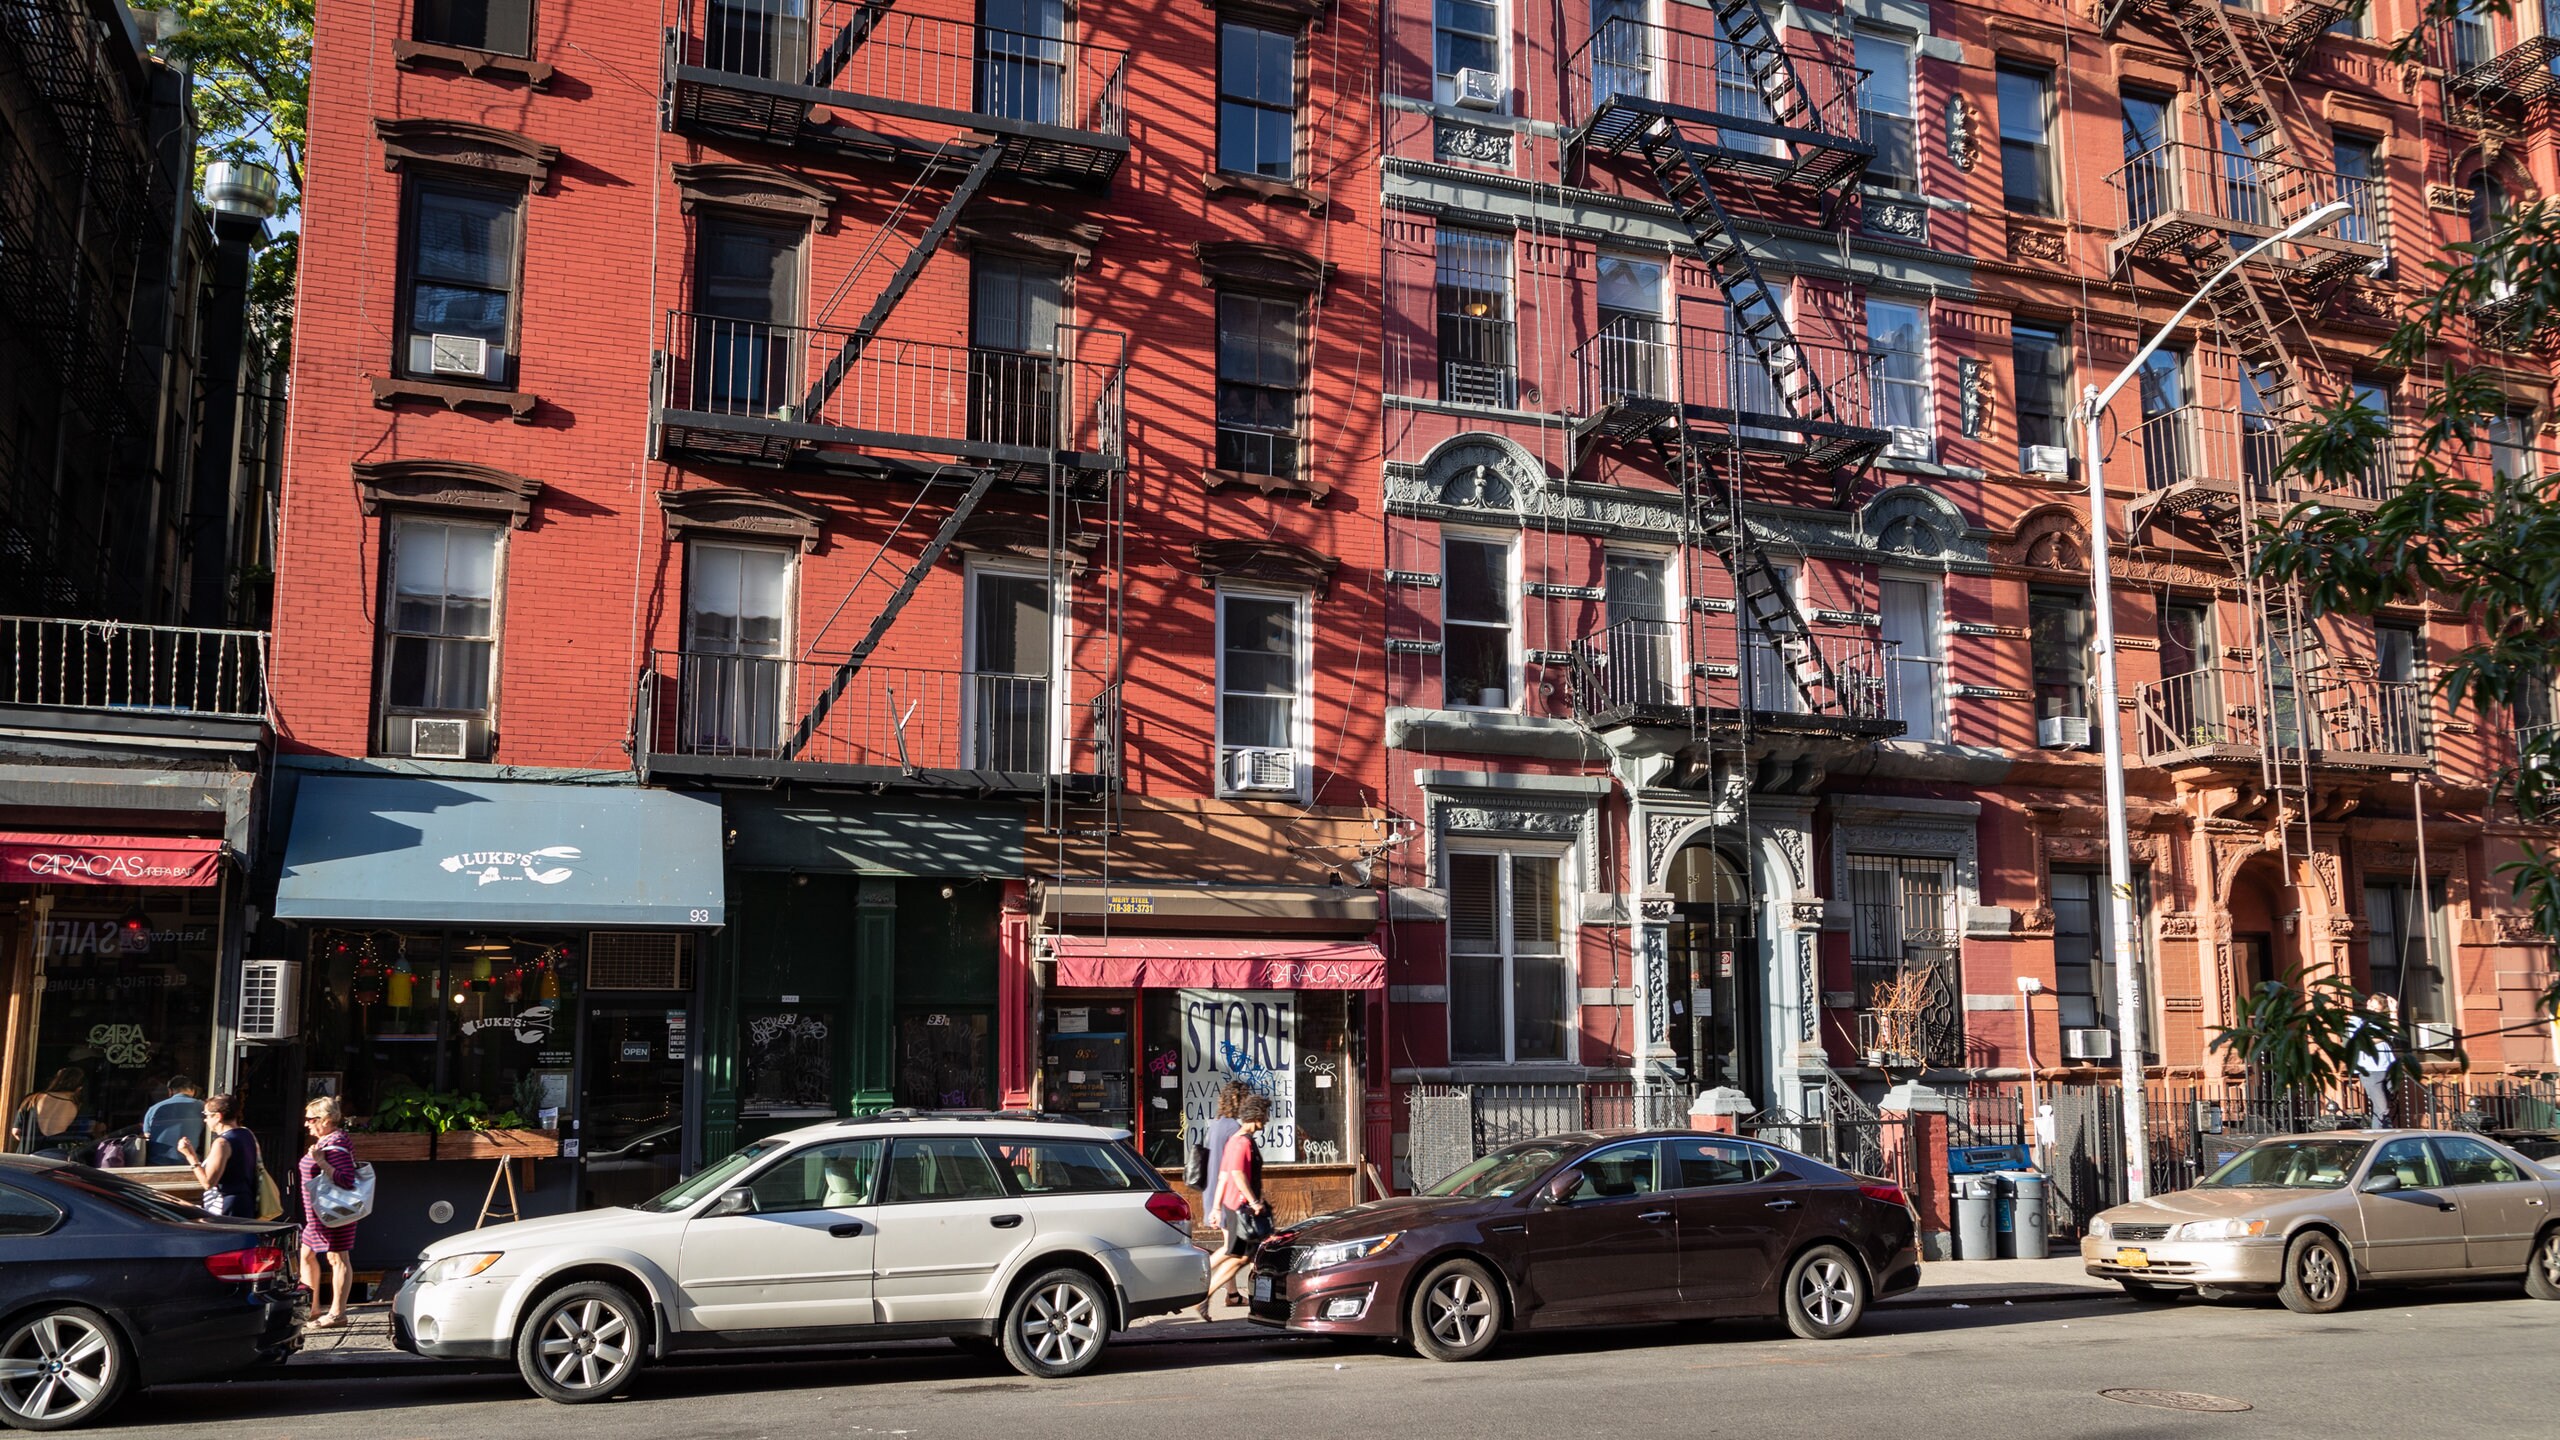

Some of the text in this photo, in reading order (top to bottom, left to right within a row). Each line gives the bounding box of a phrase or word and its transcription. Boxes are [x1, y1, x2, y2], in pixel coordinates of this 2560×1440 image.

[28, 853, 144, 877] CARACAS
[173, 867, 196, 877] BAR
[461, 852, 533, 867] LUKE'S
[1688, 875, 1699, 885] 95
[690, 909, 709, 923] 93
[1267, 963, 1350, 983] CARACAS
[475, 1017, 522, 1029] LUKE'S
[780, 1014, 795, 1024] 93
[928, 1015, 944, 1024] 93
[1187, 1001, 1291, 1073] STORE
[623, 1048, 648, 1056] OPEN
[1185, 1079, 1293, 1099] AVAABLE
[1186, 1101, 1215, 1121] CAL
